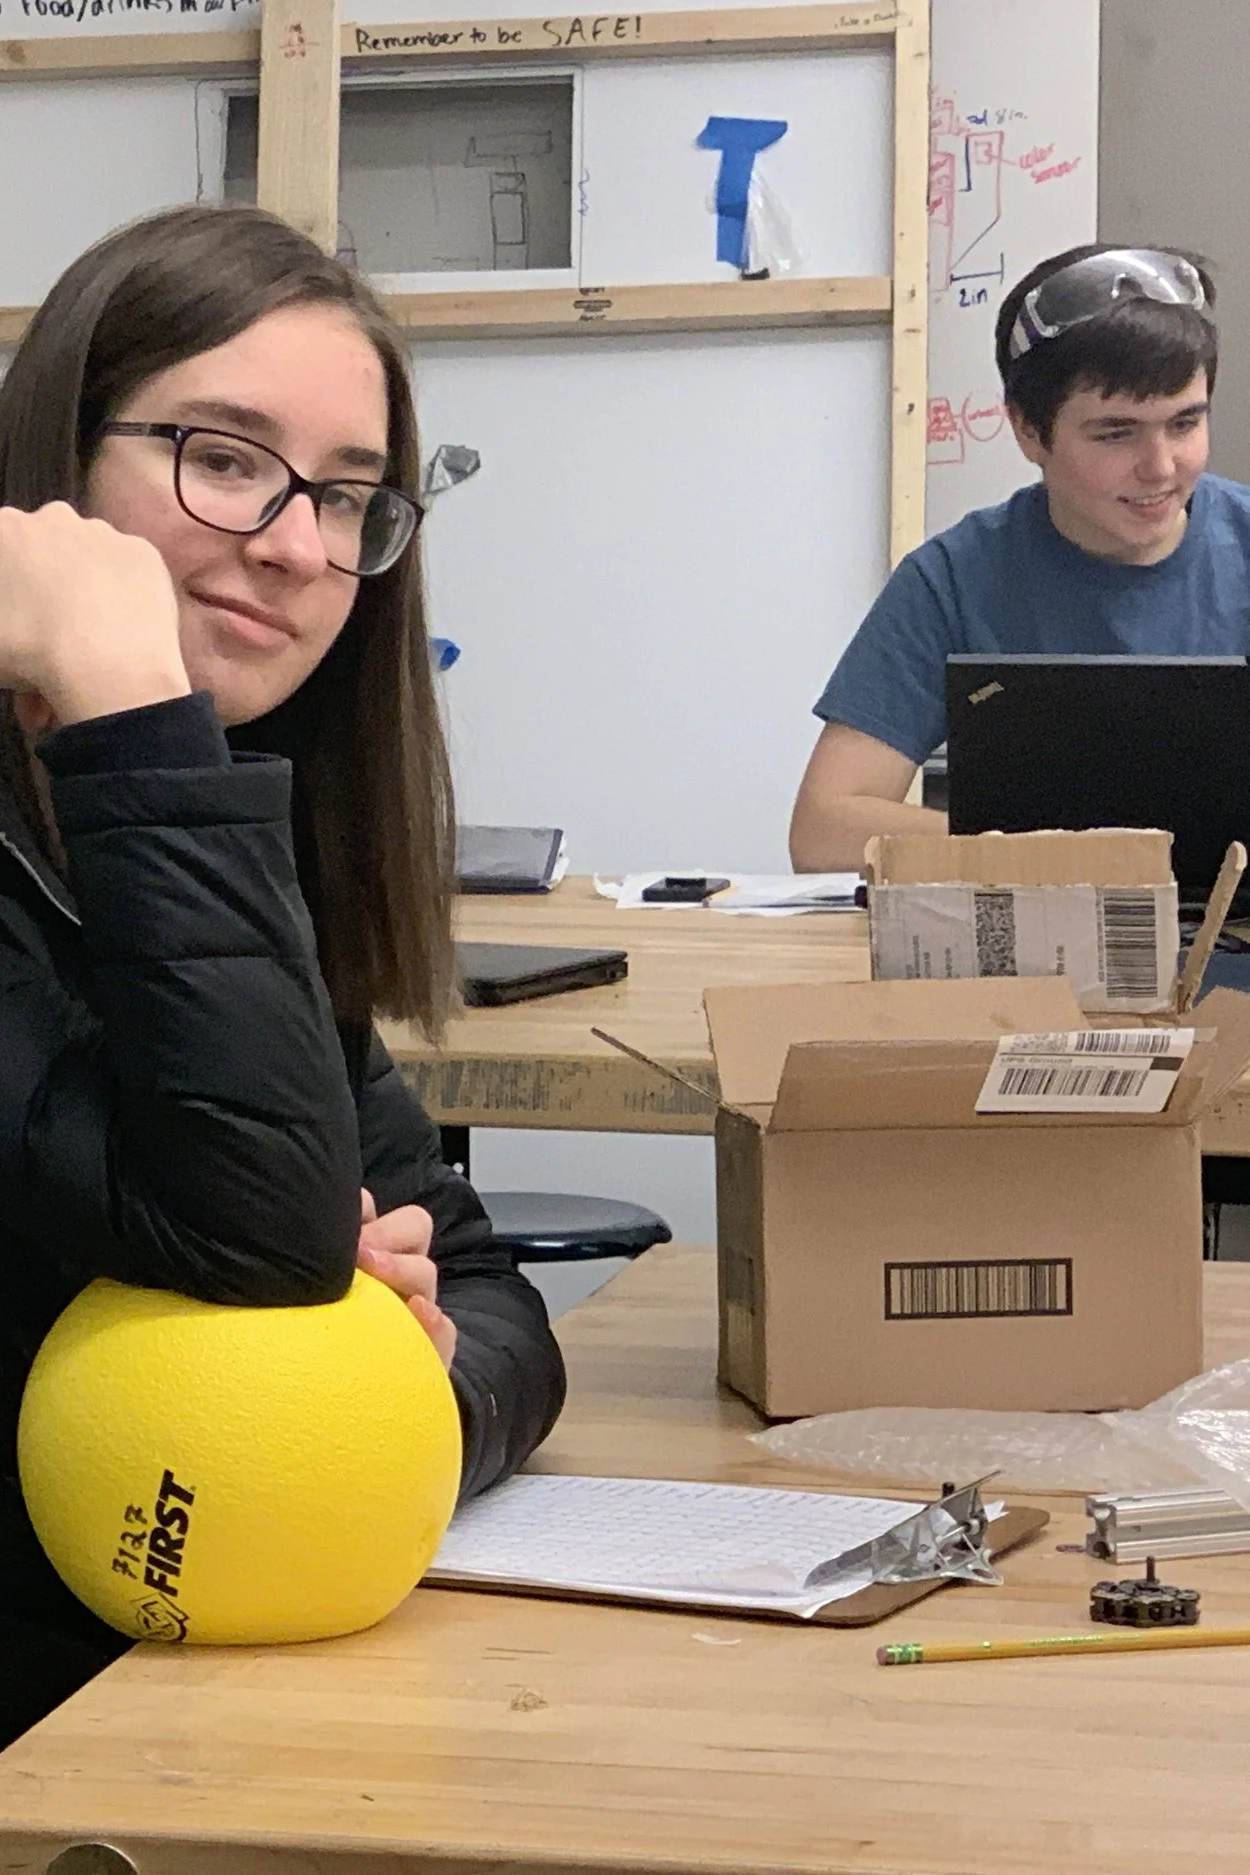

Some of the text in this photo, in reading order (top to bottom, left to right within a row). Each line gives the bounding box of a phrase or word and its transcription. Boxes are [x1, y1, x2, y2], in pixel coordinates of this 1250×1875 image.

[355, 15, 641, 53] Remember to be SAFE!
[144, 1469, 195, 1597] FIRST
